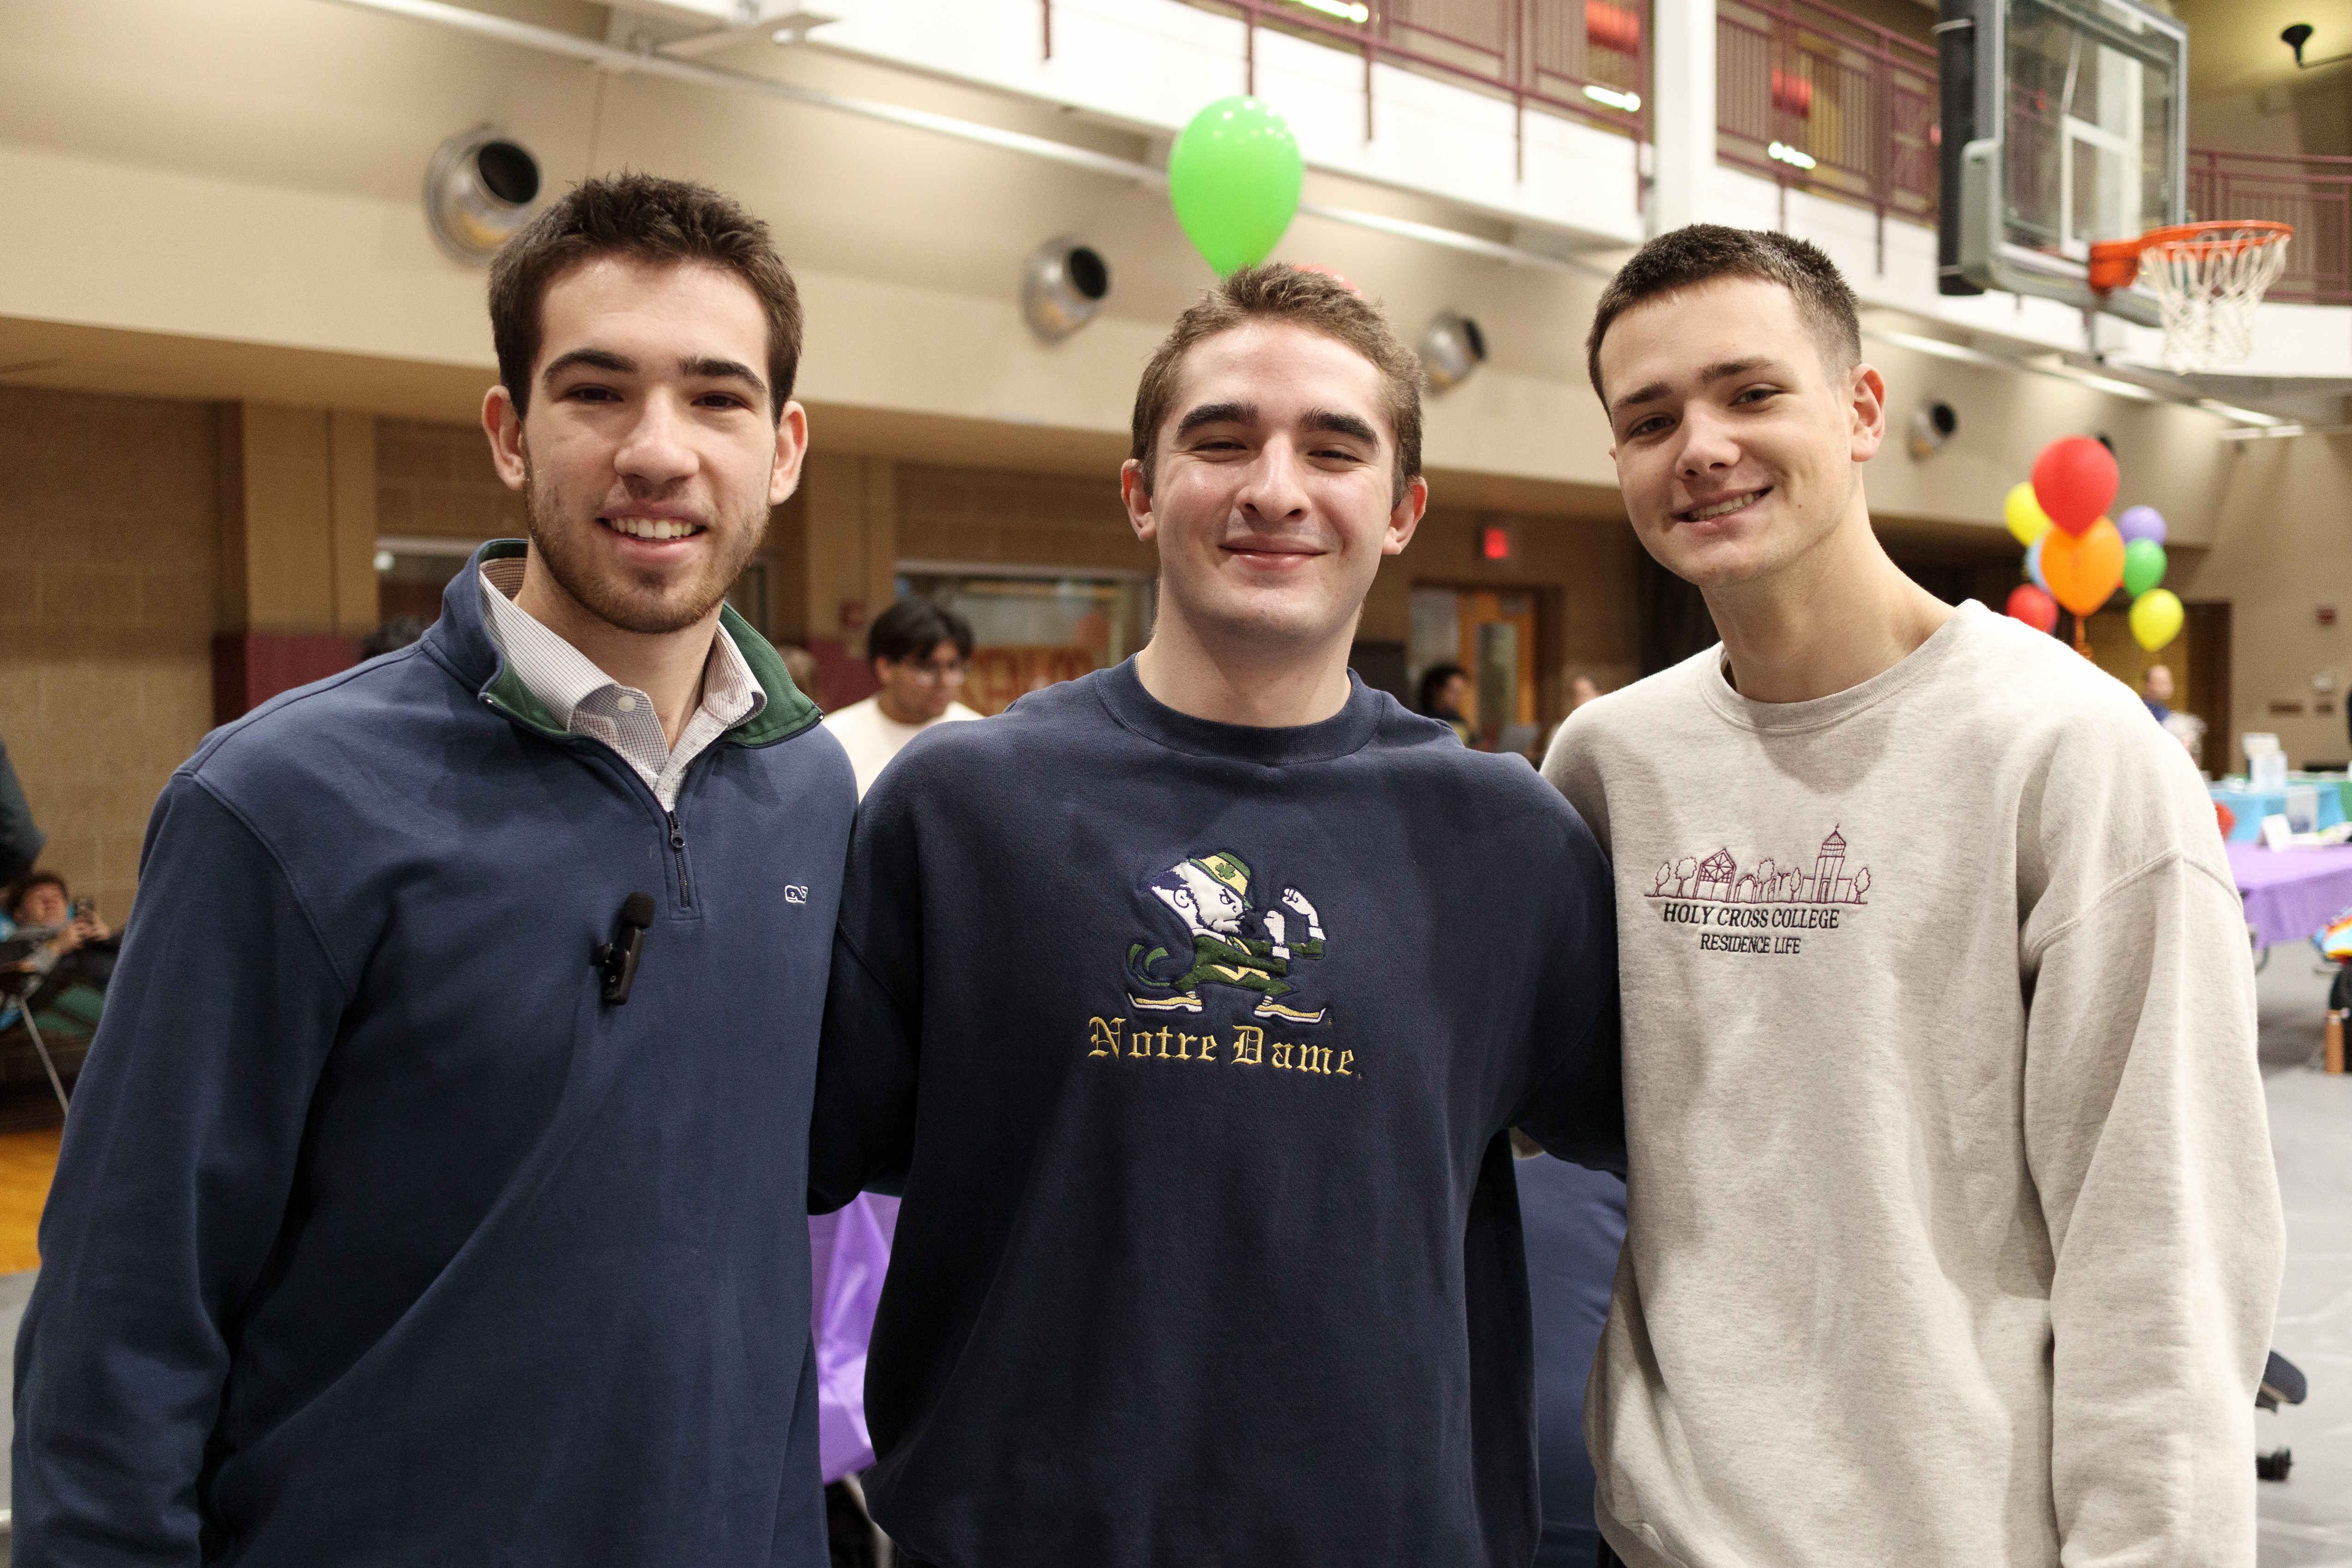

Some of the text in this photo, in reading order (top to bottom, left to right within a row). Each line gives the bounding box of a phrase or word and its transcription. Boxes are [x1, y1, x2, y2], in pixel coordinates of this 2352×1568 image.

[1663, 903, 1840, 929] HOLY CROSS COLLEGE
[1700, 933, 1802, 954] RESIDENCE LIFE
[1088, 1016, 1355, 1076] Notre Dame
